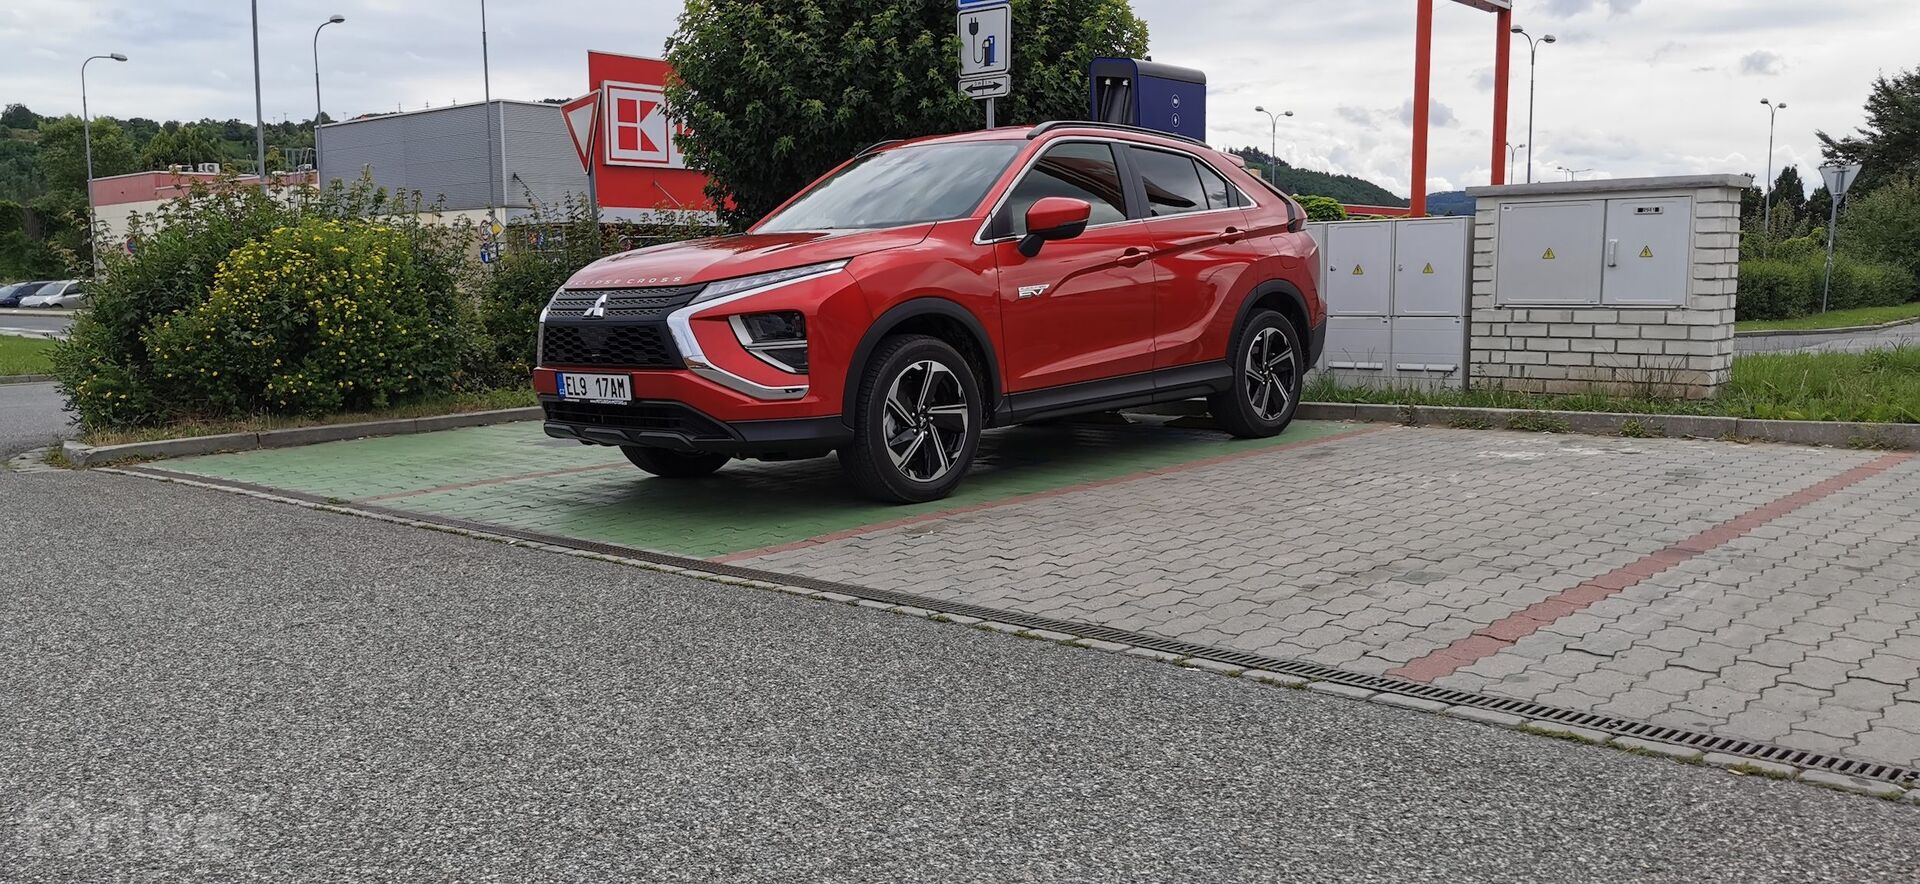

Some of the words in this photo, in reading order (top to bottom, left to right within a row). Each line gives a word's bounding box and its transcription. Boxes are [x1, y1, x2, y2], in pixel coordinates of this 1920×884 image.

[568, 278, 622, 286] ECLIPSE
[627, 276, 682, 284] CROSS
[565, 376, 588, 396] EL9
[595, 377, 626, 399] 17AM
